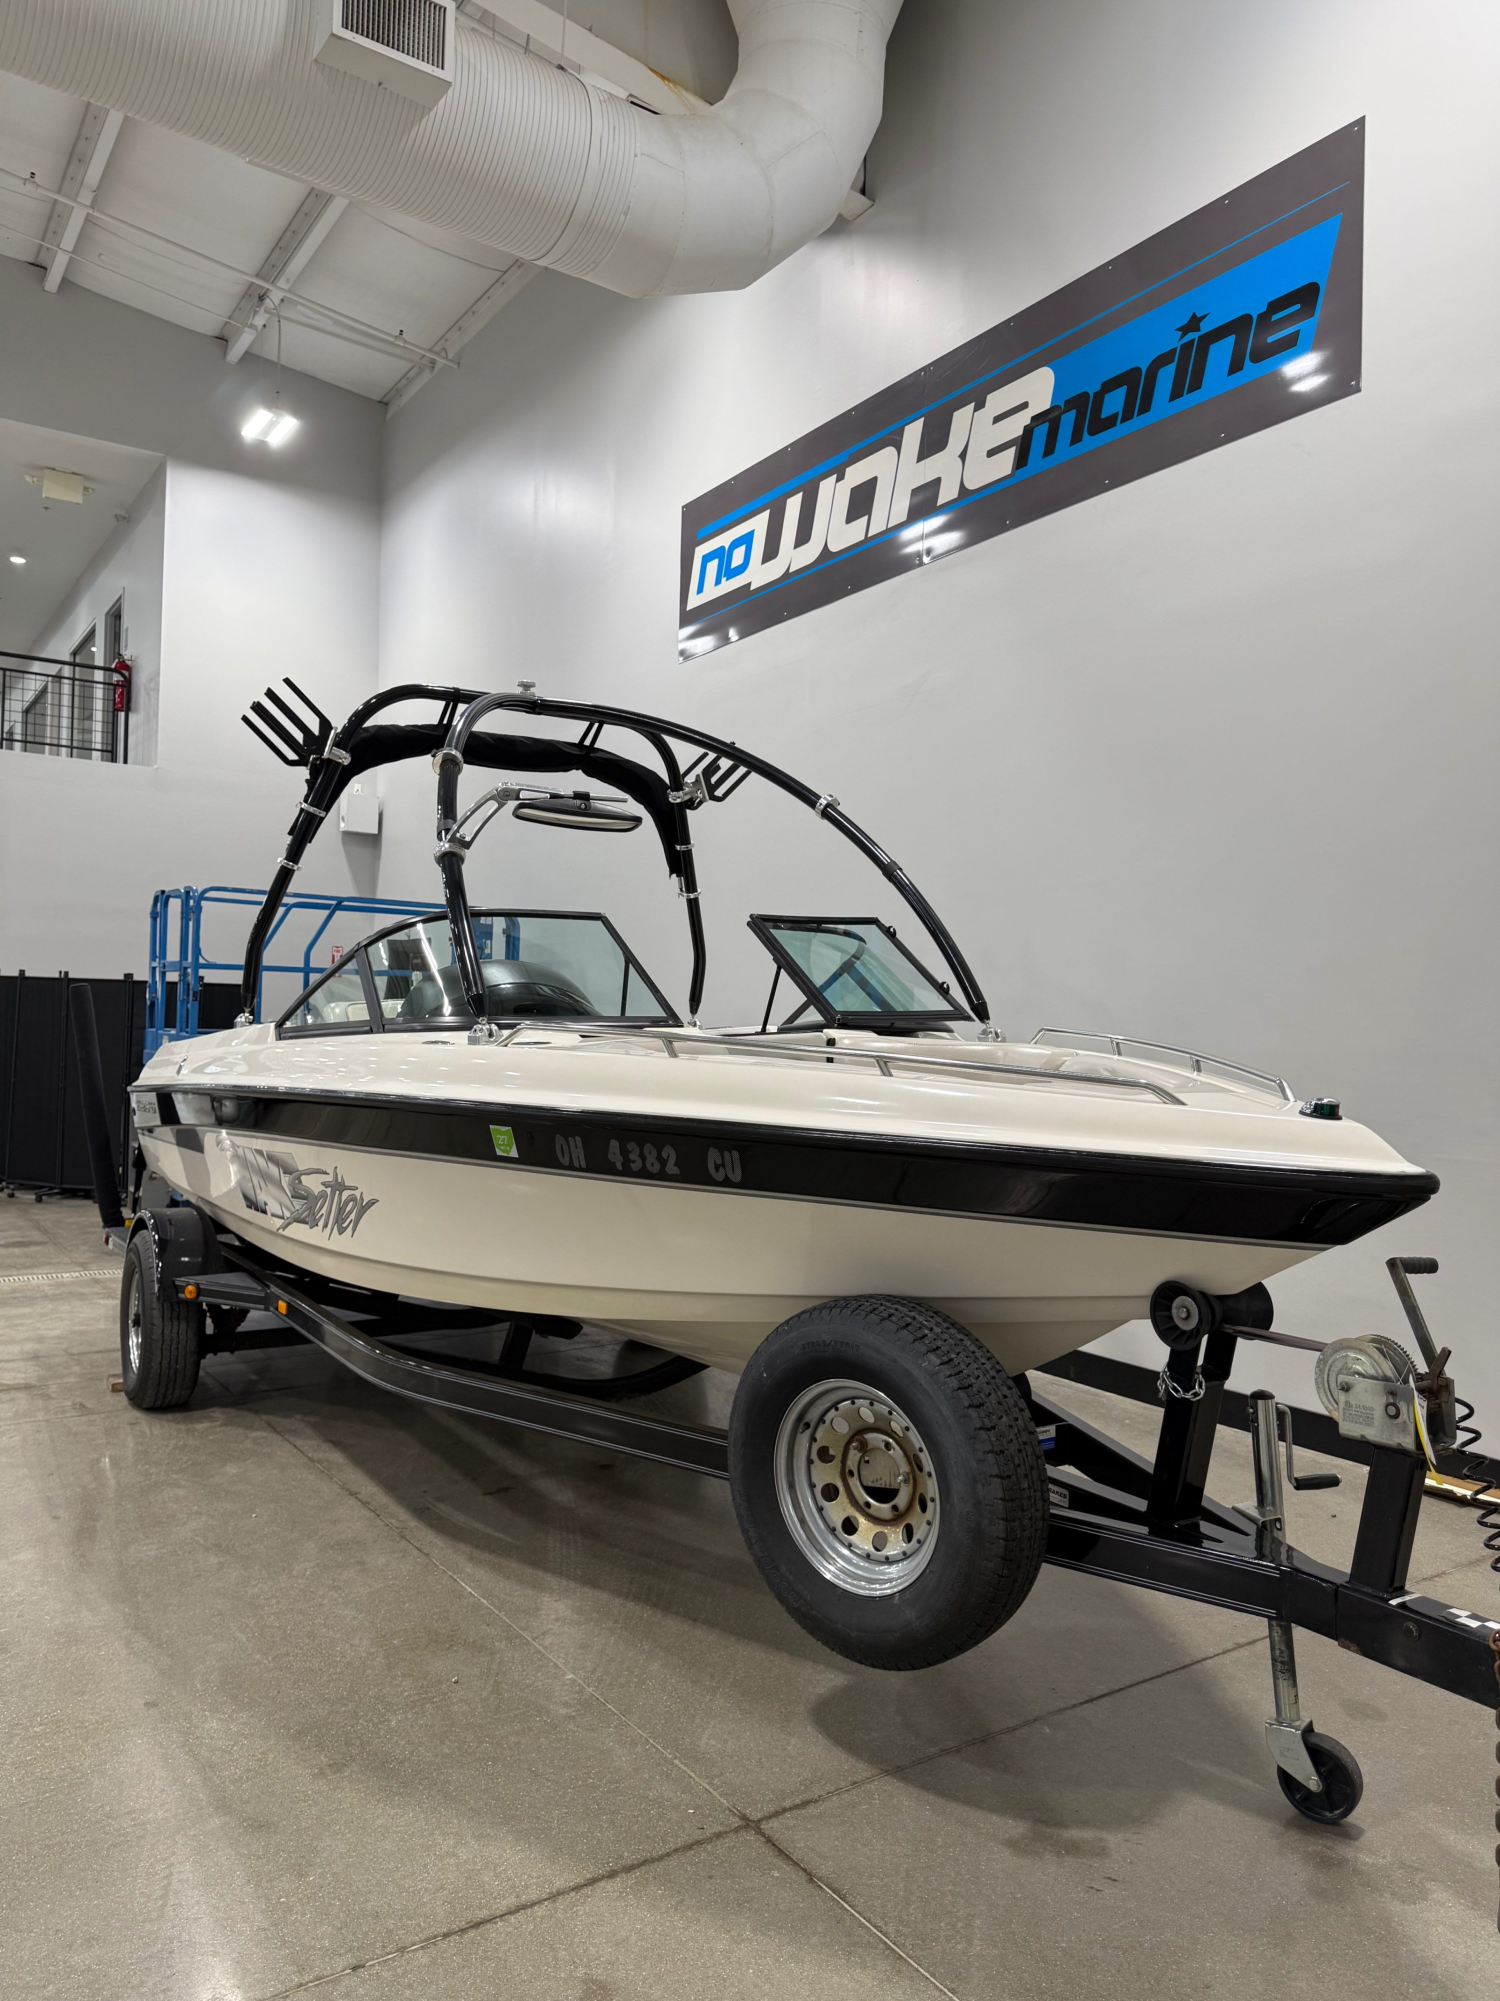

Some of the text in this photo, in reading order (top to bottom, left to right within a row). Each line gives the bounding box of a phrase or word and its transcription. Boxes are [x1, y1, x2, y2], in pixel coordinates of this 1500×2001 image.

[1016, 282, 1320, 472] marine
[555, 1134, 742, 1183] OH 4382 CU
[1048, 1487, 1067, 1499] RAKES
